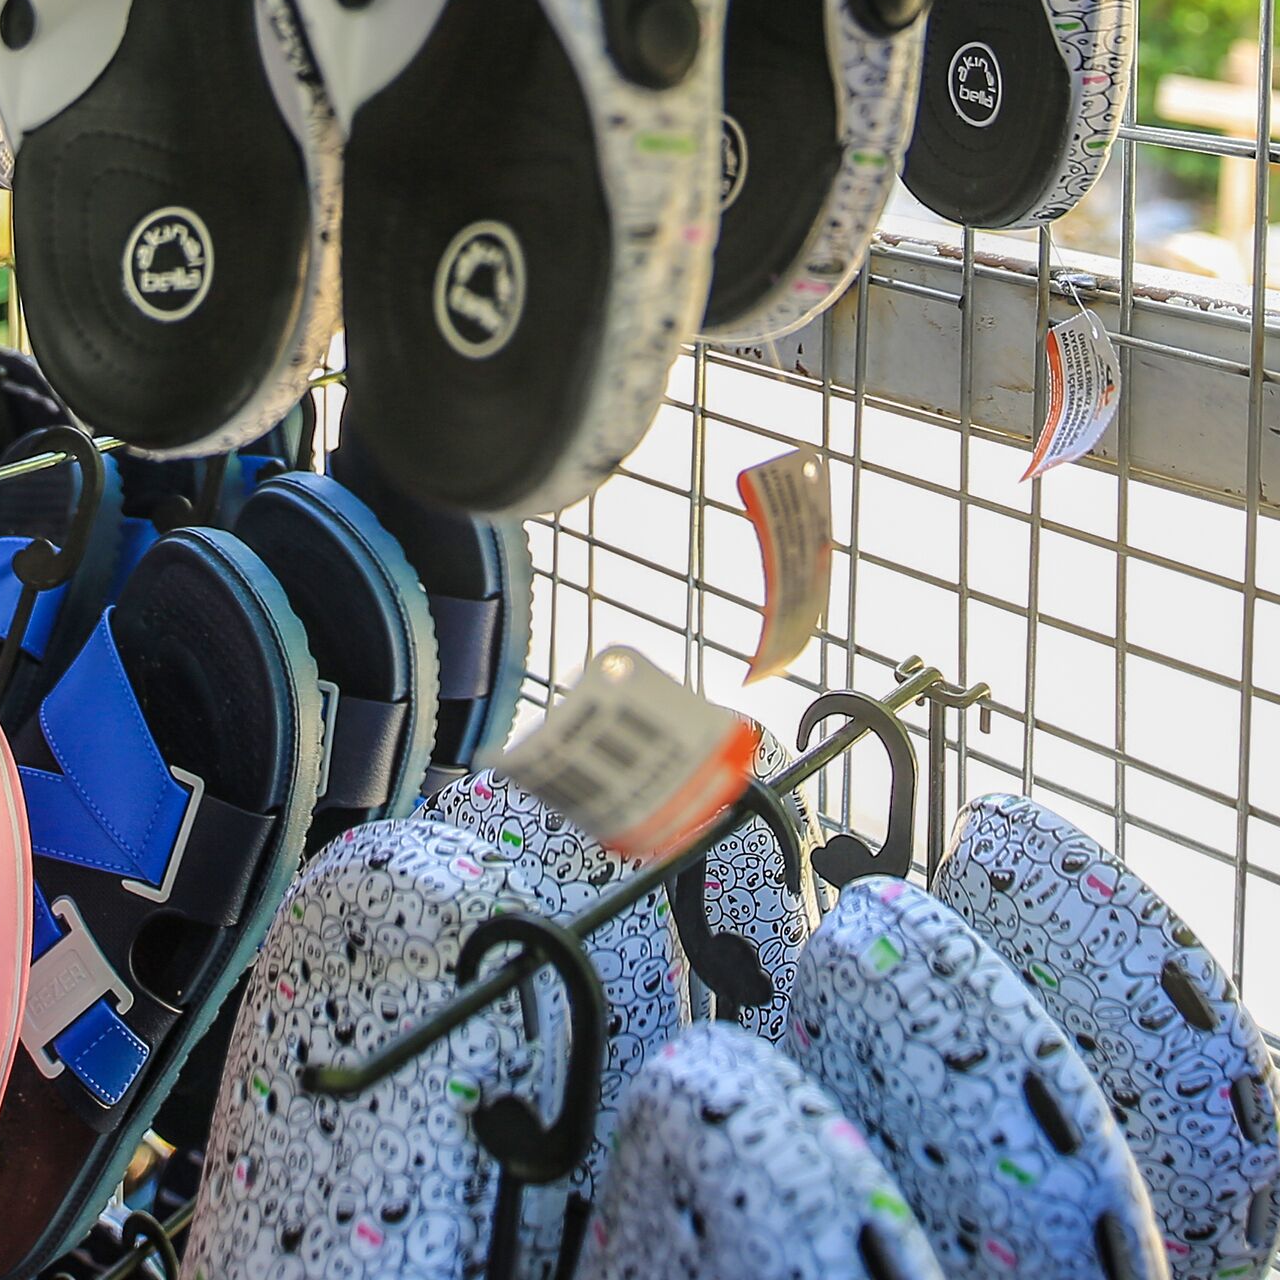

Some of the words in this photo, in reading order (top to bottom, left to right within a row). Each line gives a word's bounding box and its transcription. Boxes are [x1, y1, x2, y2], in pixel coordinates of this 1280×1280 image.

[959, 84, 993, 109] bella
[1060, 332, 1075, 371] MADDE
[28, 962, 87, 1016] GEZER
